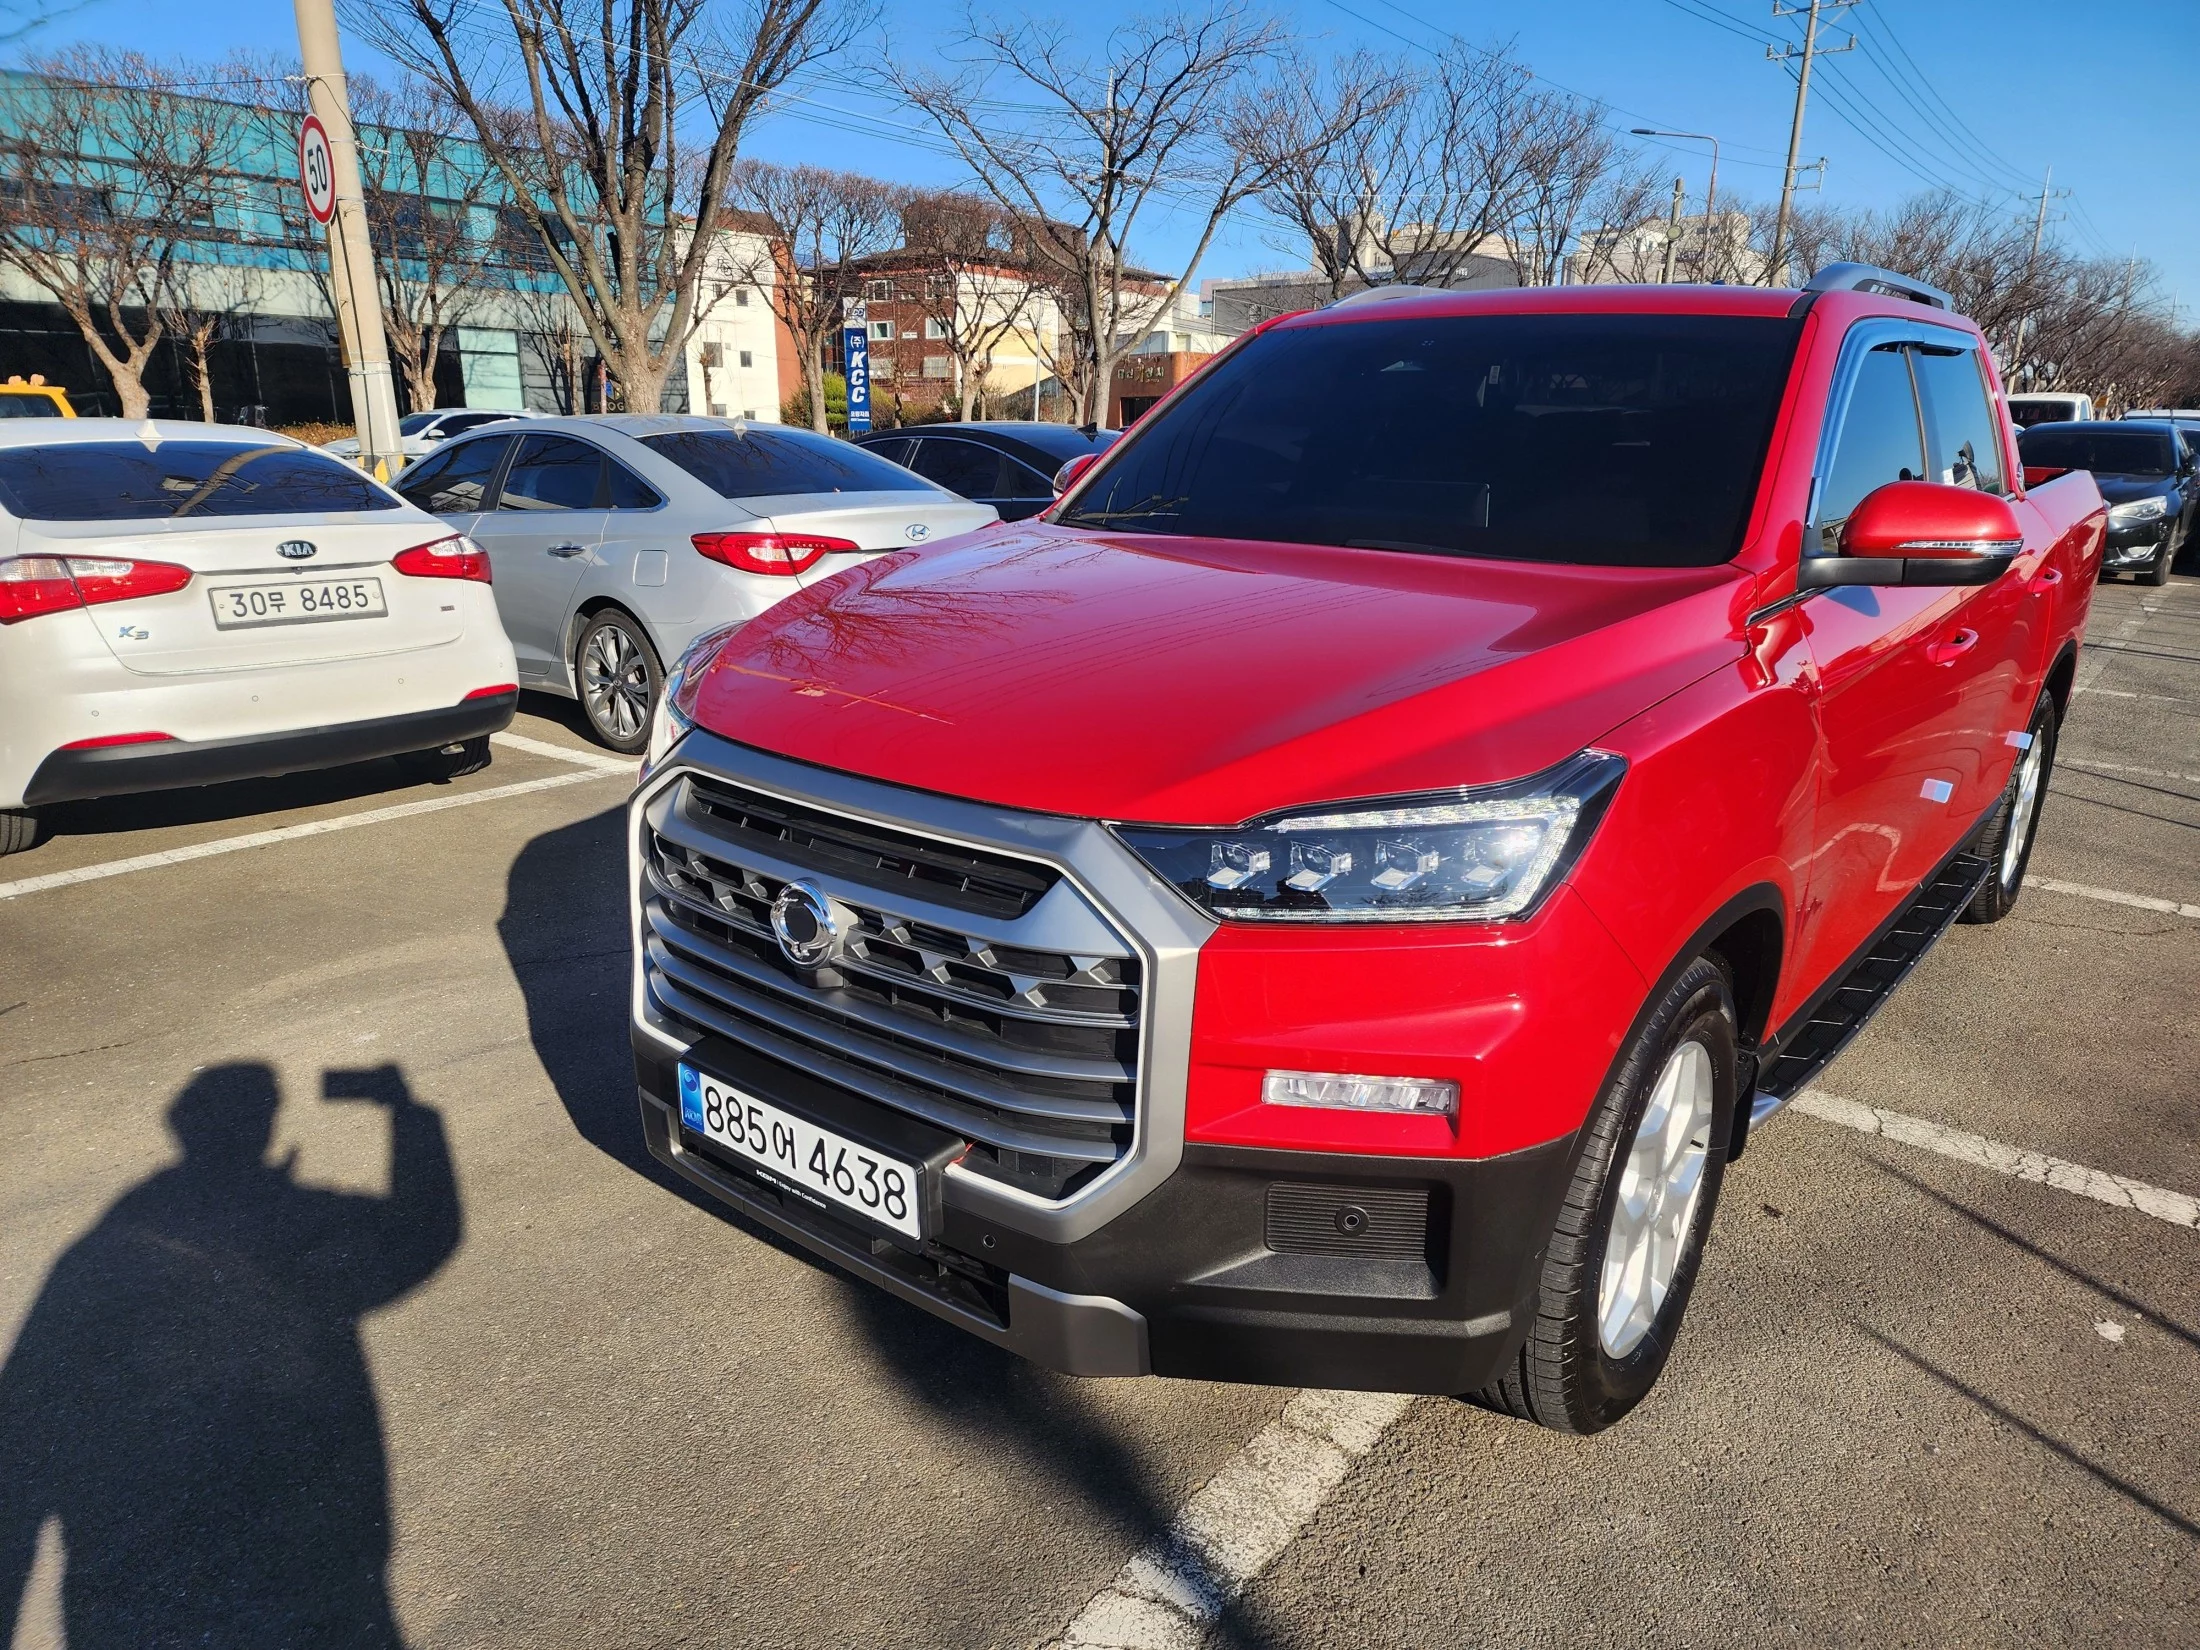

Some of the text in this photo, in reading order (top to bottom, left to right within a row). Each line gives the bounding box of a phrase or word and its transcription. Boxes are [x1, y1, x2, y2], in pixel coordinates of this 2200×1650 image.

[307, 144, 328, 195] 50
[850, 351, 867, 404] KCC
[283, 542, 314, 557] KIA
[229, 584, 369, 618] 30무 8485
[118, 625, 149, 640] K3
[684, 1106, 703, 1126] KOR
[705, 1085, 908, 1220] 885어 4638
